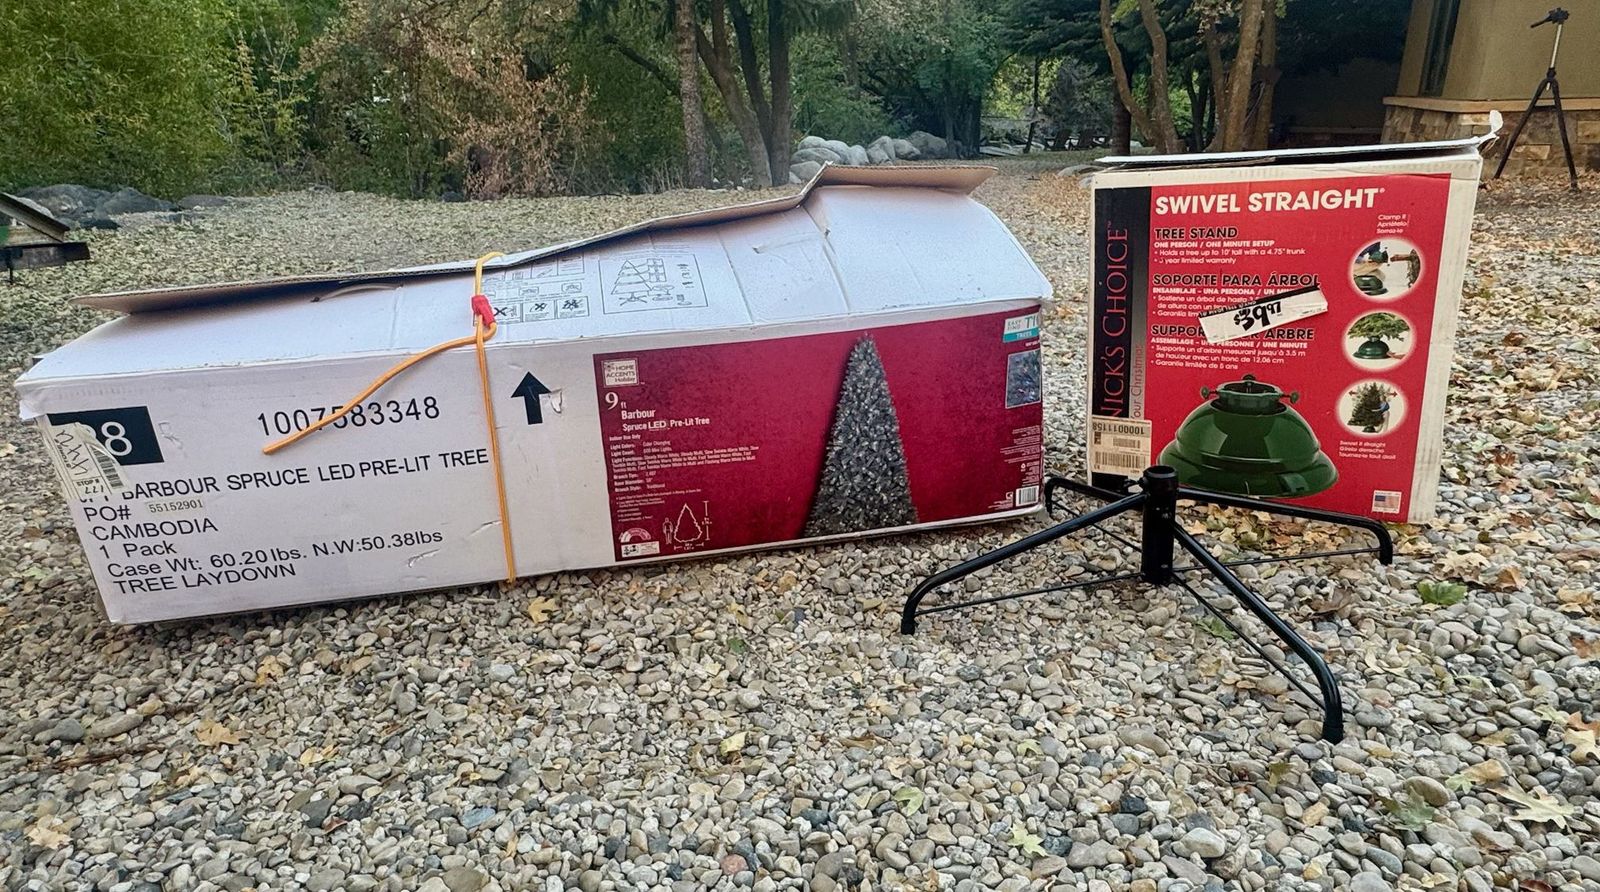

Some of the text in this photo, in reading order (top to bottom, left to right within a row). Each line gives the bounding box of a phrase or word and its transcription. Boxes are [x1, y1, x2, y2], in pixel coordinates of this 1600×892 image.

[1155, 188, 1378, 215] SWIVEL STRAIGHT
[1154, 226, 1238, 239] TREE STAND
[1153, 271, 1320, 286] SOPORTE PARA ÁRBOL
[1151, 324, 1206, 337] SUPPOR
[1263, 328, 1314, 340] ARBRE
[1151, 337, 1194, 345] ASSEMBLAGE
[605, 392, 618, 410] 9
[1131, 402, 1142, 418] our
[258, 396, 440, 436] 1007583348
[621, 409, 656, 420] Barbour
[623, 424, 647, 432] Spruce
[670, 418, 694, 427] Pre-Lit
[695, 417, 710, 425] Tree
[226, 468, 310, 490] SPRUCE
[318, 464, 355, 482] LED
[359, 455, 431, 478] PRE-LIT
[439, 449, 489, 469] TREE
[83, 500, 204, 522] PO# 55152901
[92, 518, 218, 541] CAMBODIA
[100, 541, 177, 559] 1 Pack
[107, 531, 443, 578] Case Wt: 60.20 lbs. N.W:50.38lbs
[113, 563, 296, 594] TREE LAYDOWN
